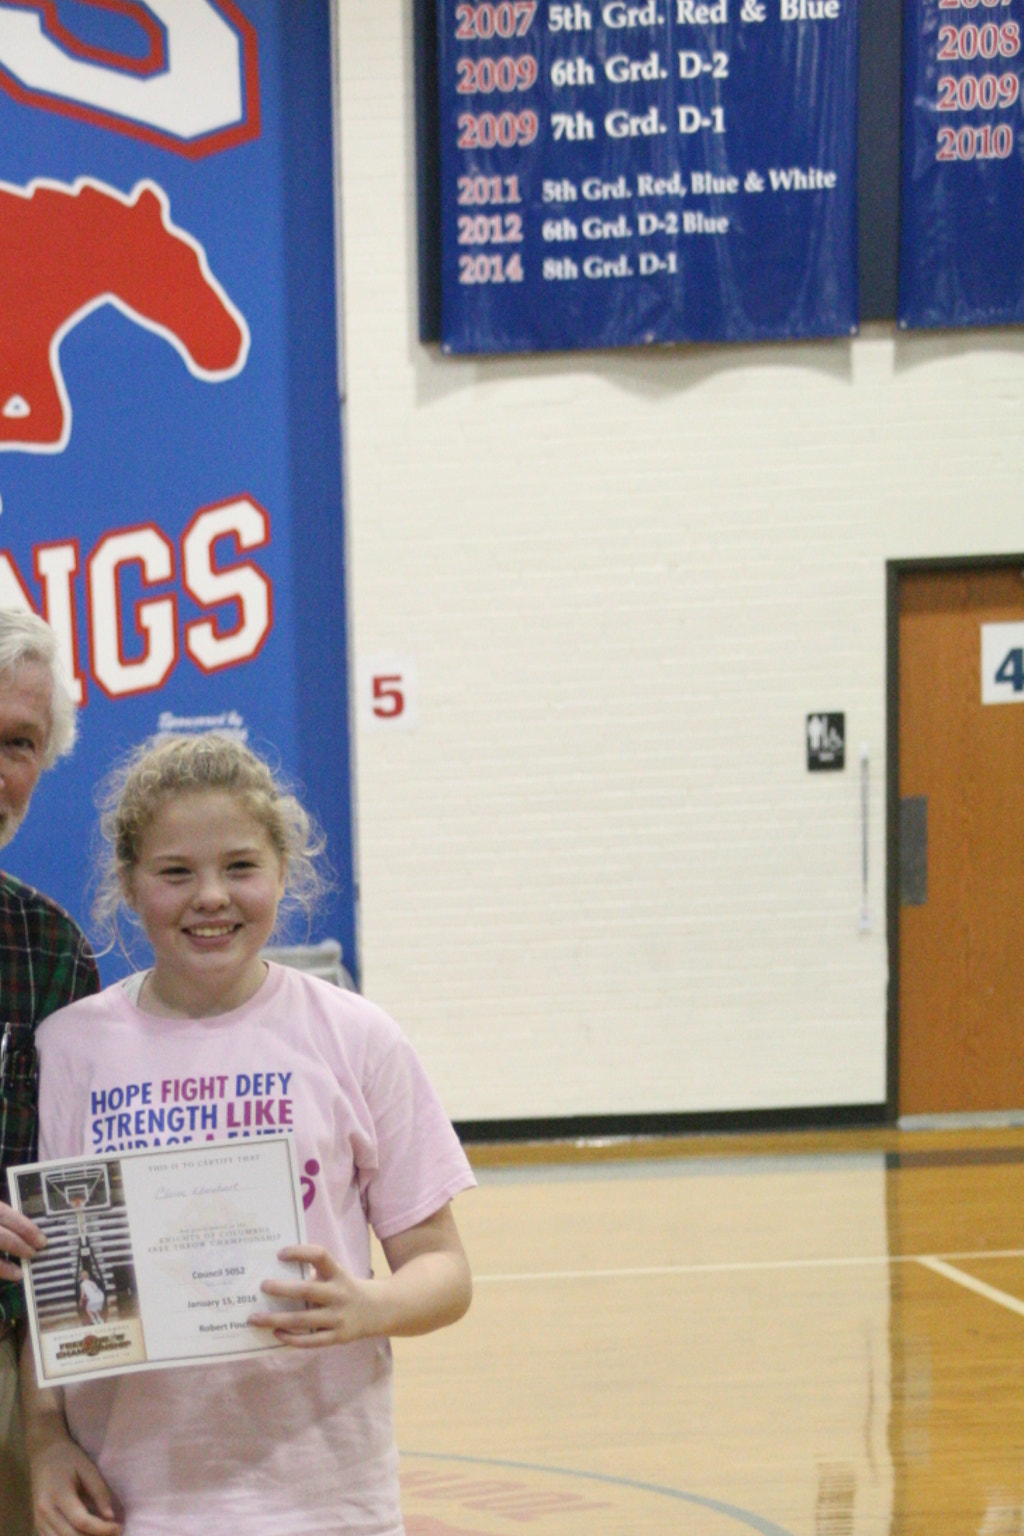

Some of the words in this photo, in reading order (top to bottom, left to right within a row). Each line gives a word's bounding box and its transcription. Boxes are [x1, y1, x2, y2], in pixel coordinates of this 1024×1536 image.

[454, 2, 538, 40] 2007
[547, 4, 591, 32] 5th
[602, 0, 665, 29] Grd.
[676, 0, 728, 25] Red
[740, 0, 766, 22] &
[780, 0, 840, 21] Blue
[937, 22, 1021, 60] 2008
[455, 54, 538, 94] 2009
[550, 58, 595, 87] 6th
[605, 52, 668, 83] Grd.
[678, 51, 730, 80] D-2
[936, 72, 1020, 111] 2009
[456, 110, 539, 149] 2009
[550, 112, 595, 141] 7th
[604, 106, 667, 138] Grd.
[678, 106, 727, 134] D-1
[936, 124, 1013, 161] 2010
[457, 174, 522, 205] 2011
[542, 179, 577, 204] 5th
[582, 174, 632, 201] Grd.
[637, 172, 687, 198] Red,
[691, 171, 739, 195] Blue
[744, 170, 765, 192] &
[769, 167, 837, 191] White
[457, 213, 523, 245] 2012
[542, 217, 577, 243] 6th
[582, 213, 632, 240] Grd.
[638, 212, 679, 236] D-2
[682, 211, 729, 235] Blue
[458, 253, 524, 285] 2014
[542, 256, 578, 282] 8th
[583, 253, 633, 279] Grd.
[639, 252, 678, 276] D-1
[994, 647, 1024, 693] 4
[371, 673, 405, 720] 5
[91, 1082, 153, 1116] HOPE
[161, 1075, 229, 1104] FIGHT
[236, 1072, 293, 1097] DEFY
[92, 1103, 218, 1145] STRENGTH
[227, 1099, 294, 1129] LIKE
[192, 1267, 223, 1280] Council
[187, 1298, 220, 1309] January
[199, 1323, 228, 1333] Robert
